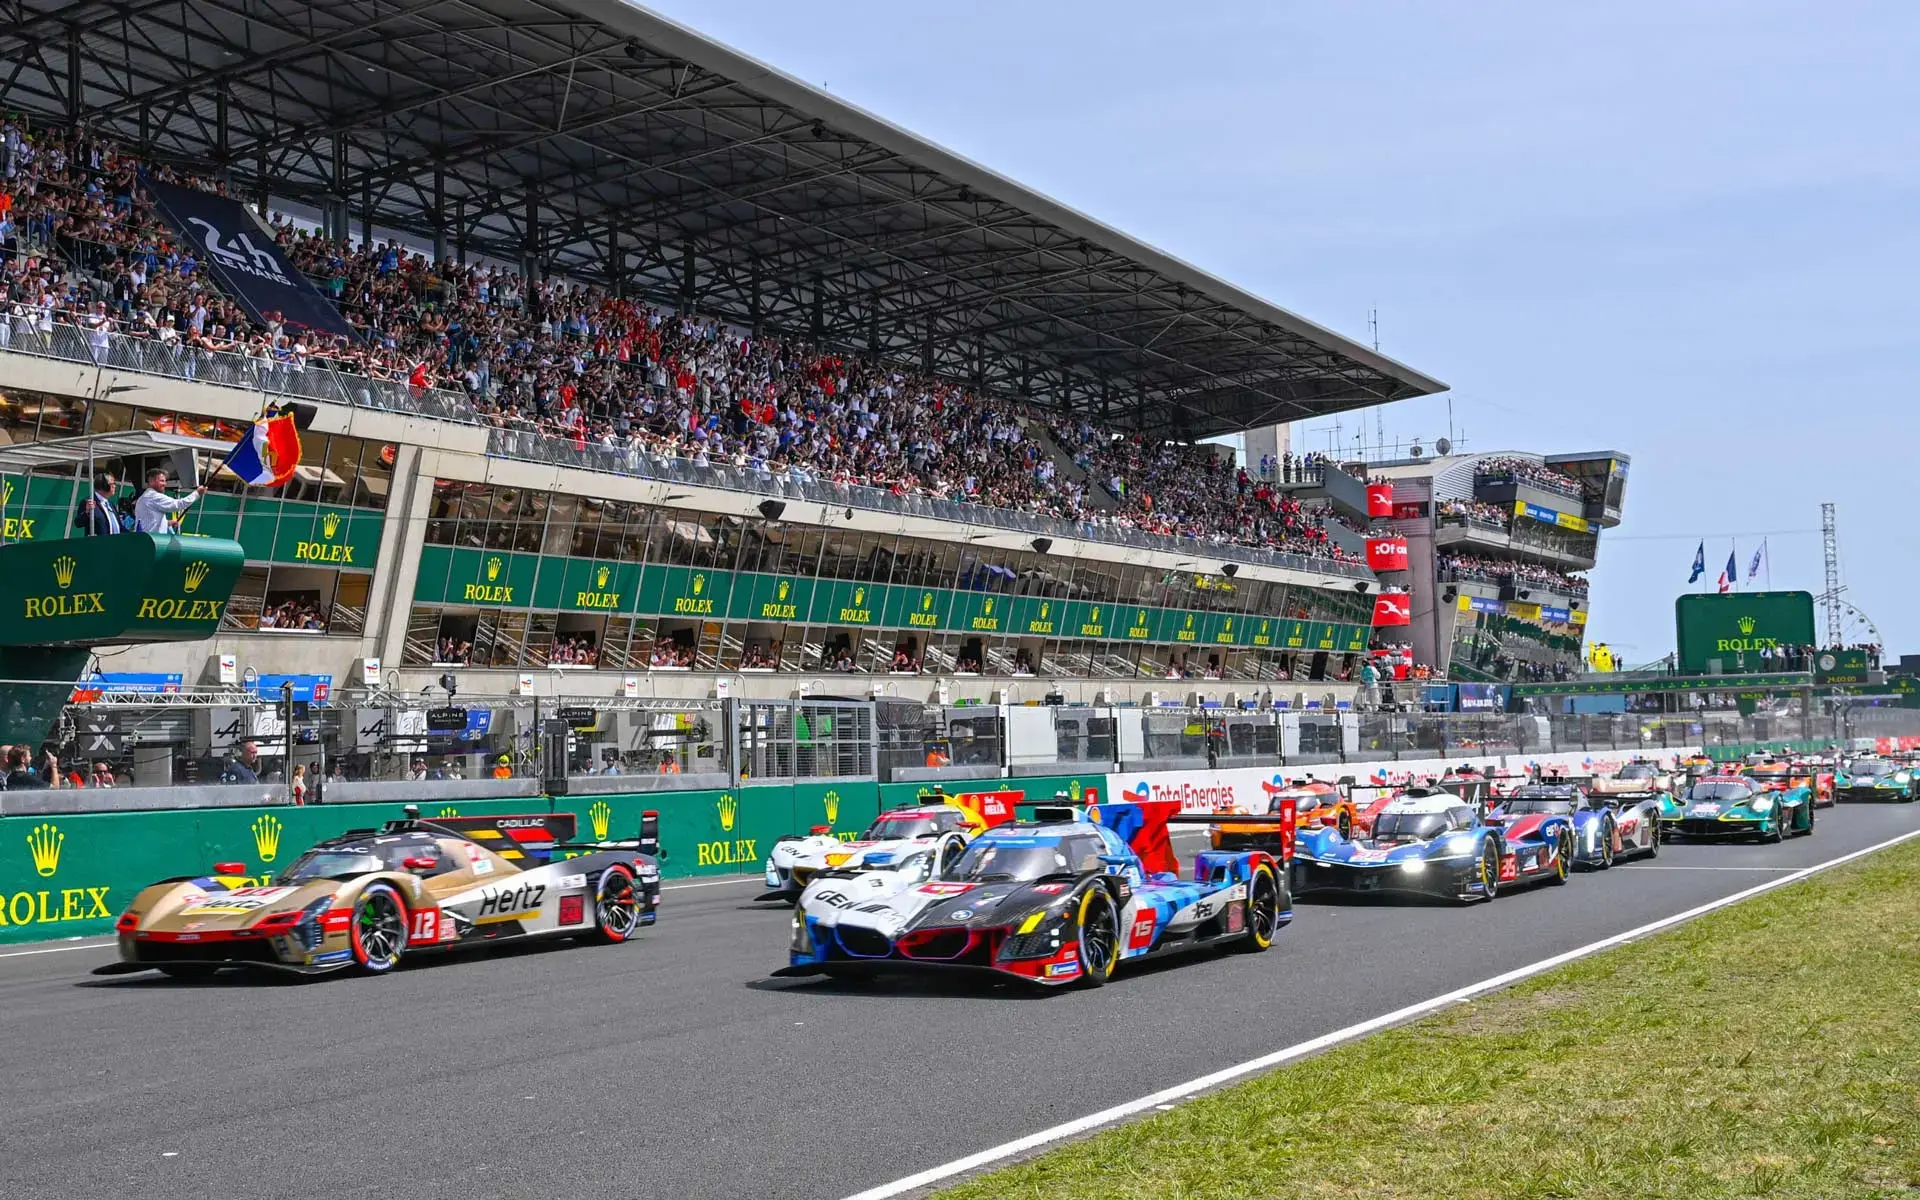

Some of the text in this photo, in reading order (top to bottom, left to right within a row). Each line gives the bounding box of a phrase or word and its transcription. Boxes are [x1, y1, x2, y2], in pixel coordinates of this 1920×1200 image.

[213, 254, 292, 285] LE MANS
[296, 542, 354, 562] ROLEX
[464, 584, 513, 602] ROLEX
[576, 592, 619, 608] ROLEX
[25, 593, 105, 618] ROLEX
[137, 598, 223, 620] ROLEX
[674, 598, 713, 613] ROLEX
[762, 604, 796, 618] ROLEX
[840, 608, 870, 622] ROLEX
[909, 613, 938, 626] ROLEX
[972, 617, 998, 629] ROLEX
[1029, 621, 1053, 633] ROLEX
[1081, 624, 1103, 636] ROLEX
[1717, 638, 1777, 652] ROLEX
[469, 730, 481, 740] 36
[1152, 784, 1235, 809] TotalEnergies
[496, 818, 545, 828] CADILLAC
[697, 840, 758, 866] ROLEX
[1500, 856, 1516, 878] 35
[479, 882, 546, 917] Hertz
[410, 911, 436, 940] 12
[1134, 920, 1153, 937] 15
